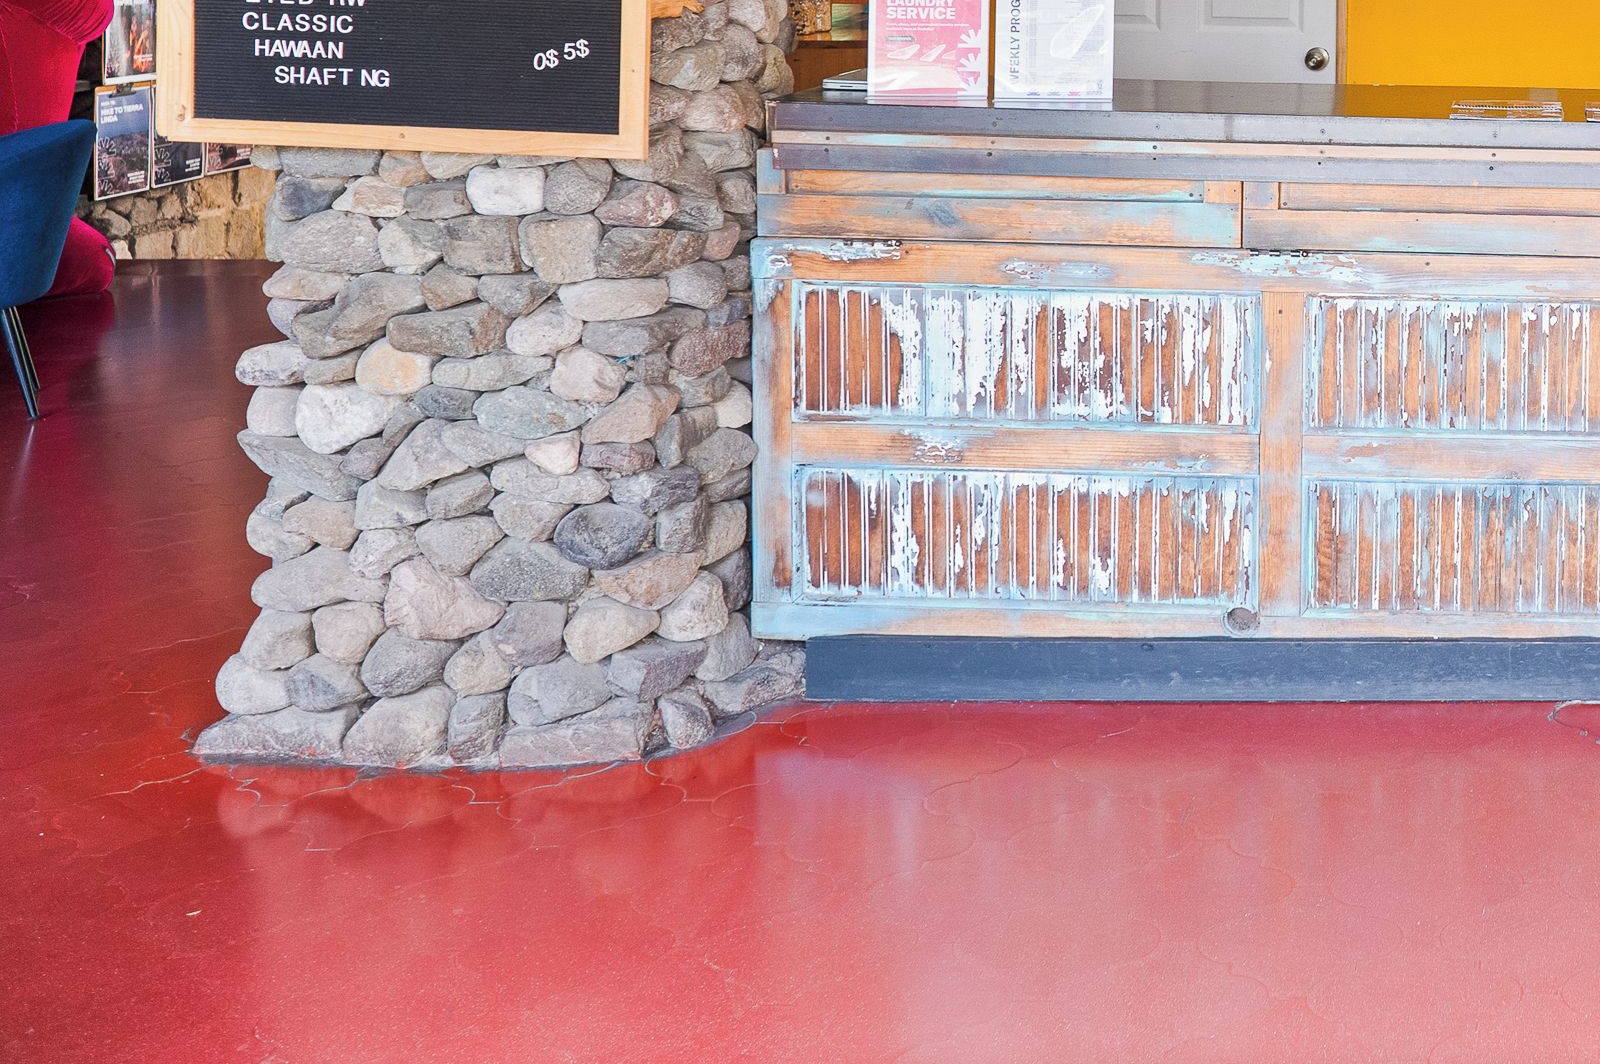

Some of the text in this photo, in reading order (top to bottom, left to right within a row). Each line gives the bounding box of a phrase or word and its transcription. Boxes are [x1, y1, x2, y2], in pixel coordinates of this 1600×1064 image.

[886, 7, 956, 20] SERVICE
[242, 11, 354, 34] CLASSIC
[254, 38, 344, 60] HAWAAN
[114, 106, 123, 114] TO
